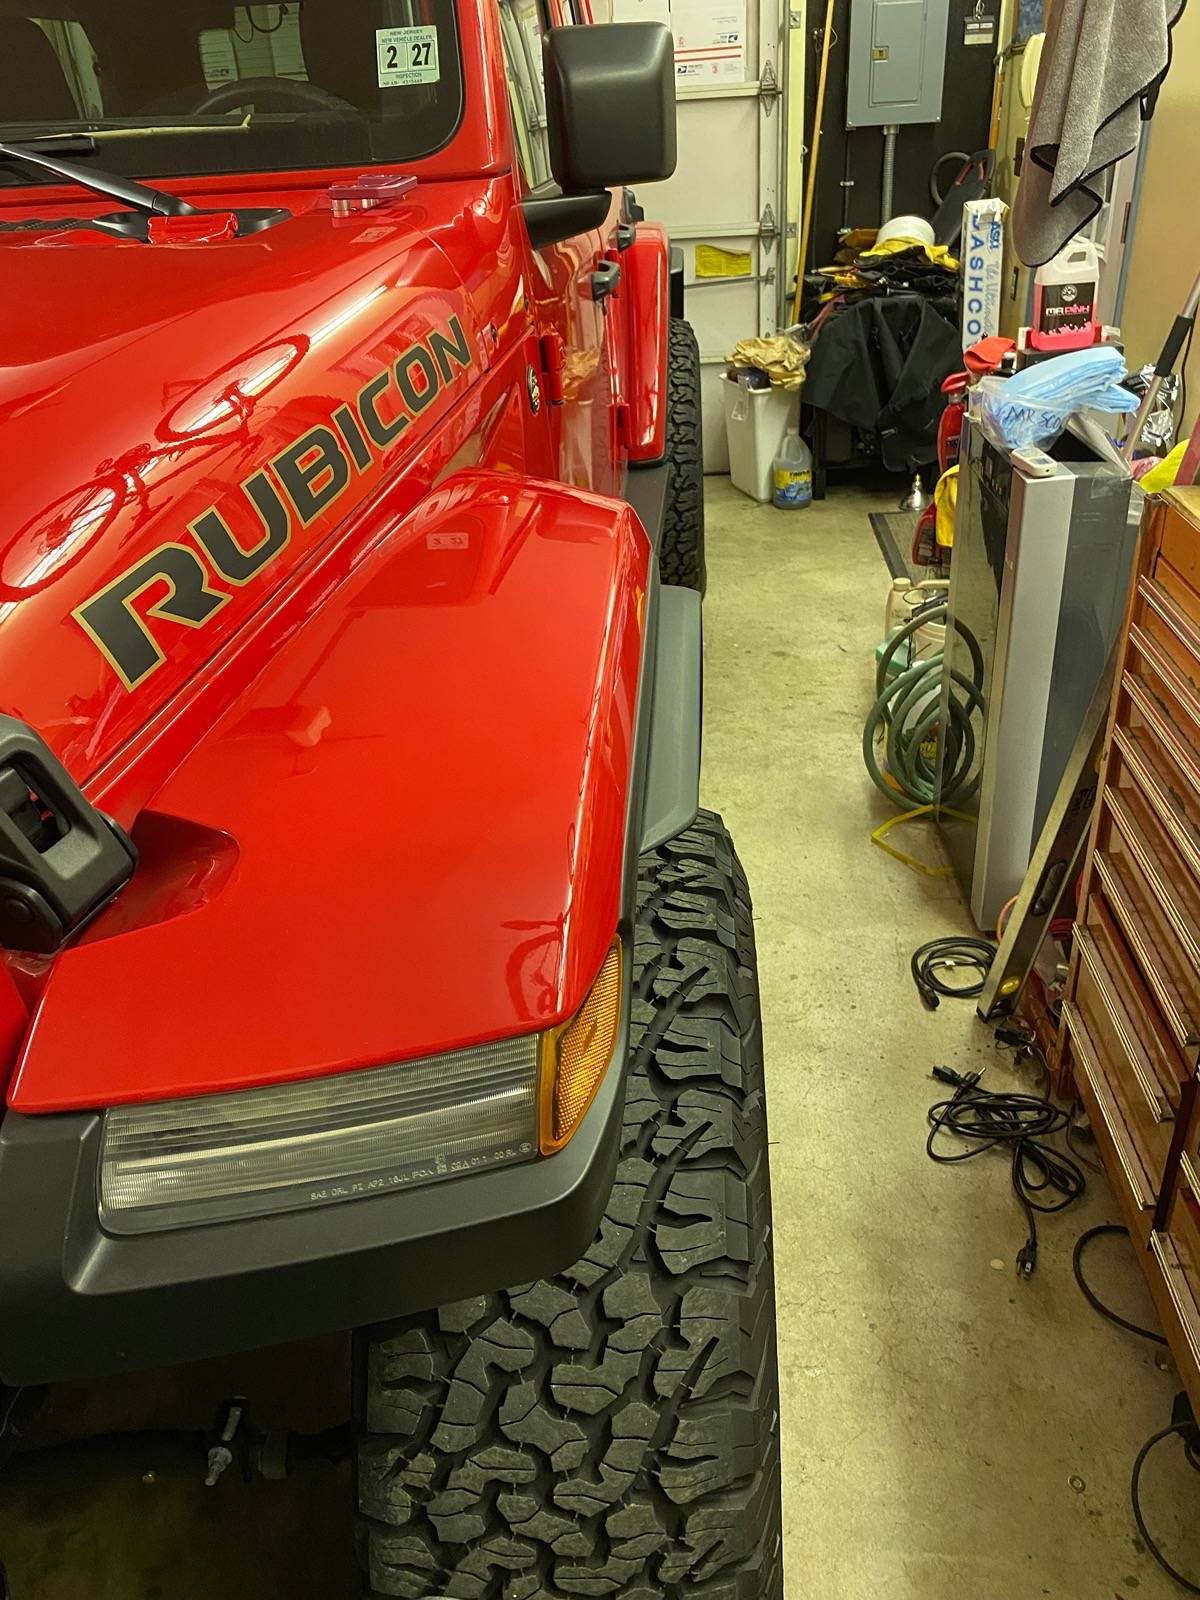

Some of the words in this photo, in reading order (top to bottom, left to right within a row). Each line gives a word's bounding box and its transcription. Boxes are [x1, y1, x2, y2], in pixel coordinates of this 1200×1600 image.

[386, 46, 398, 68] 2
[412, 42, 431, 66] 27
[70, 313, 472, 693] RUBICON
[310, 1190, 327, 1200] SAE
